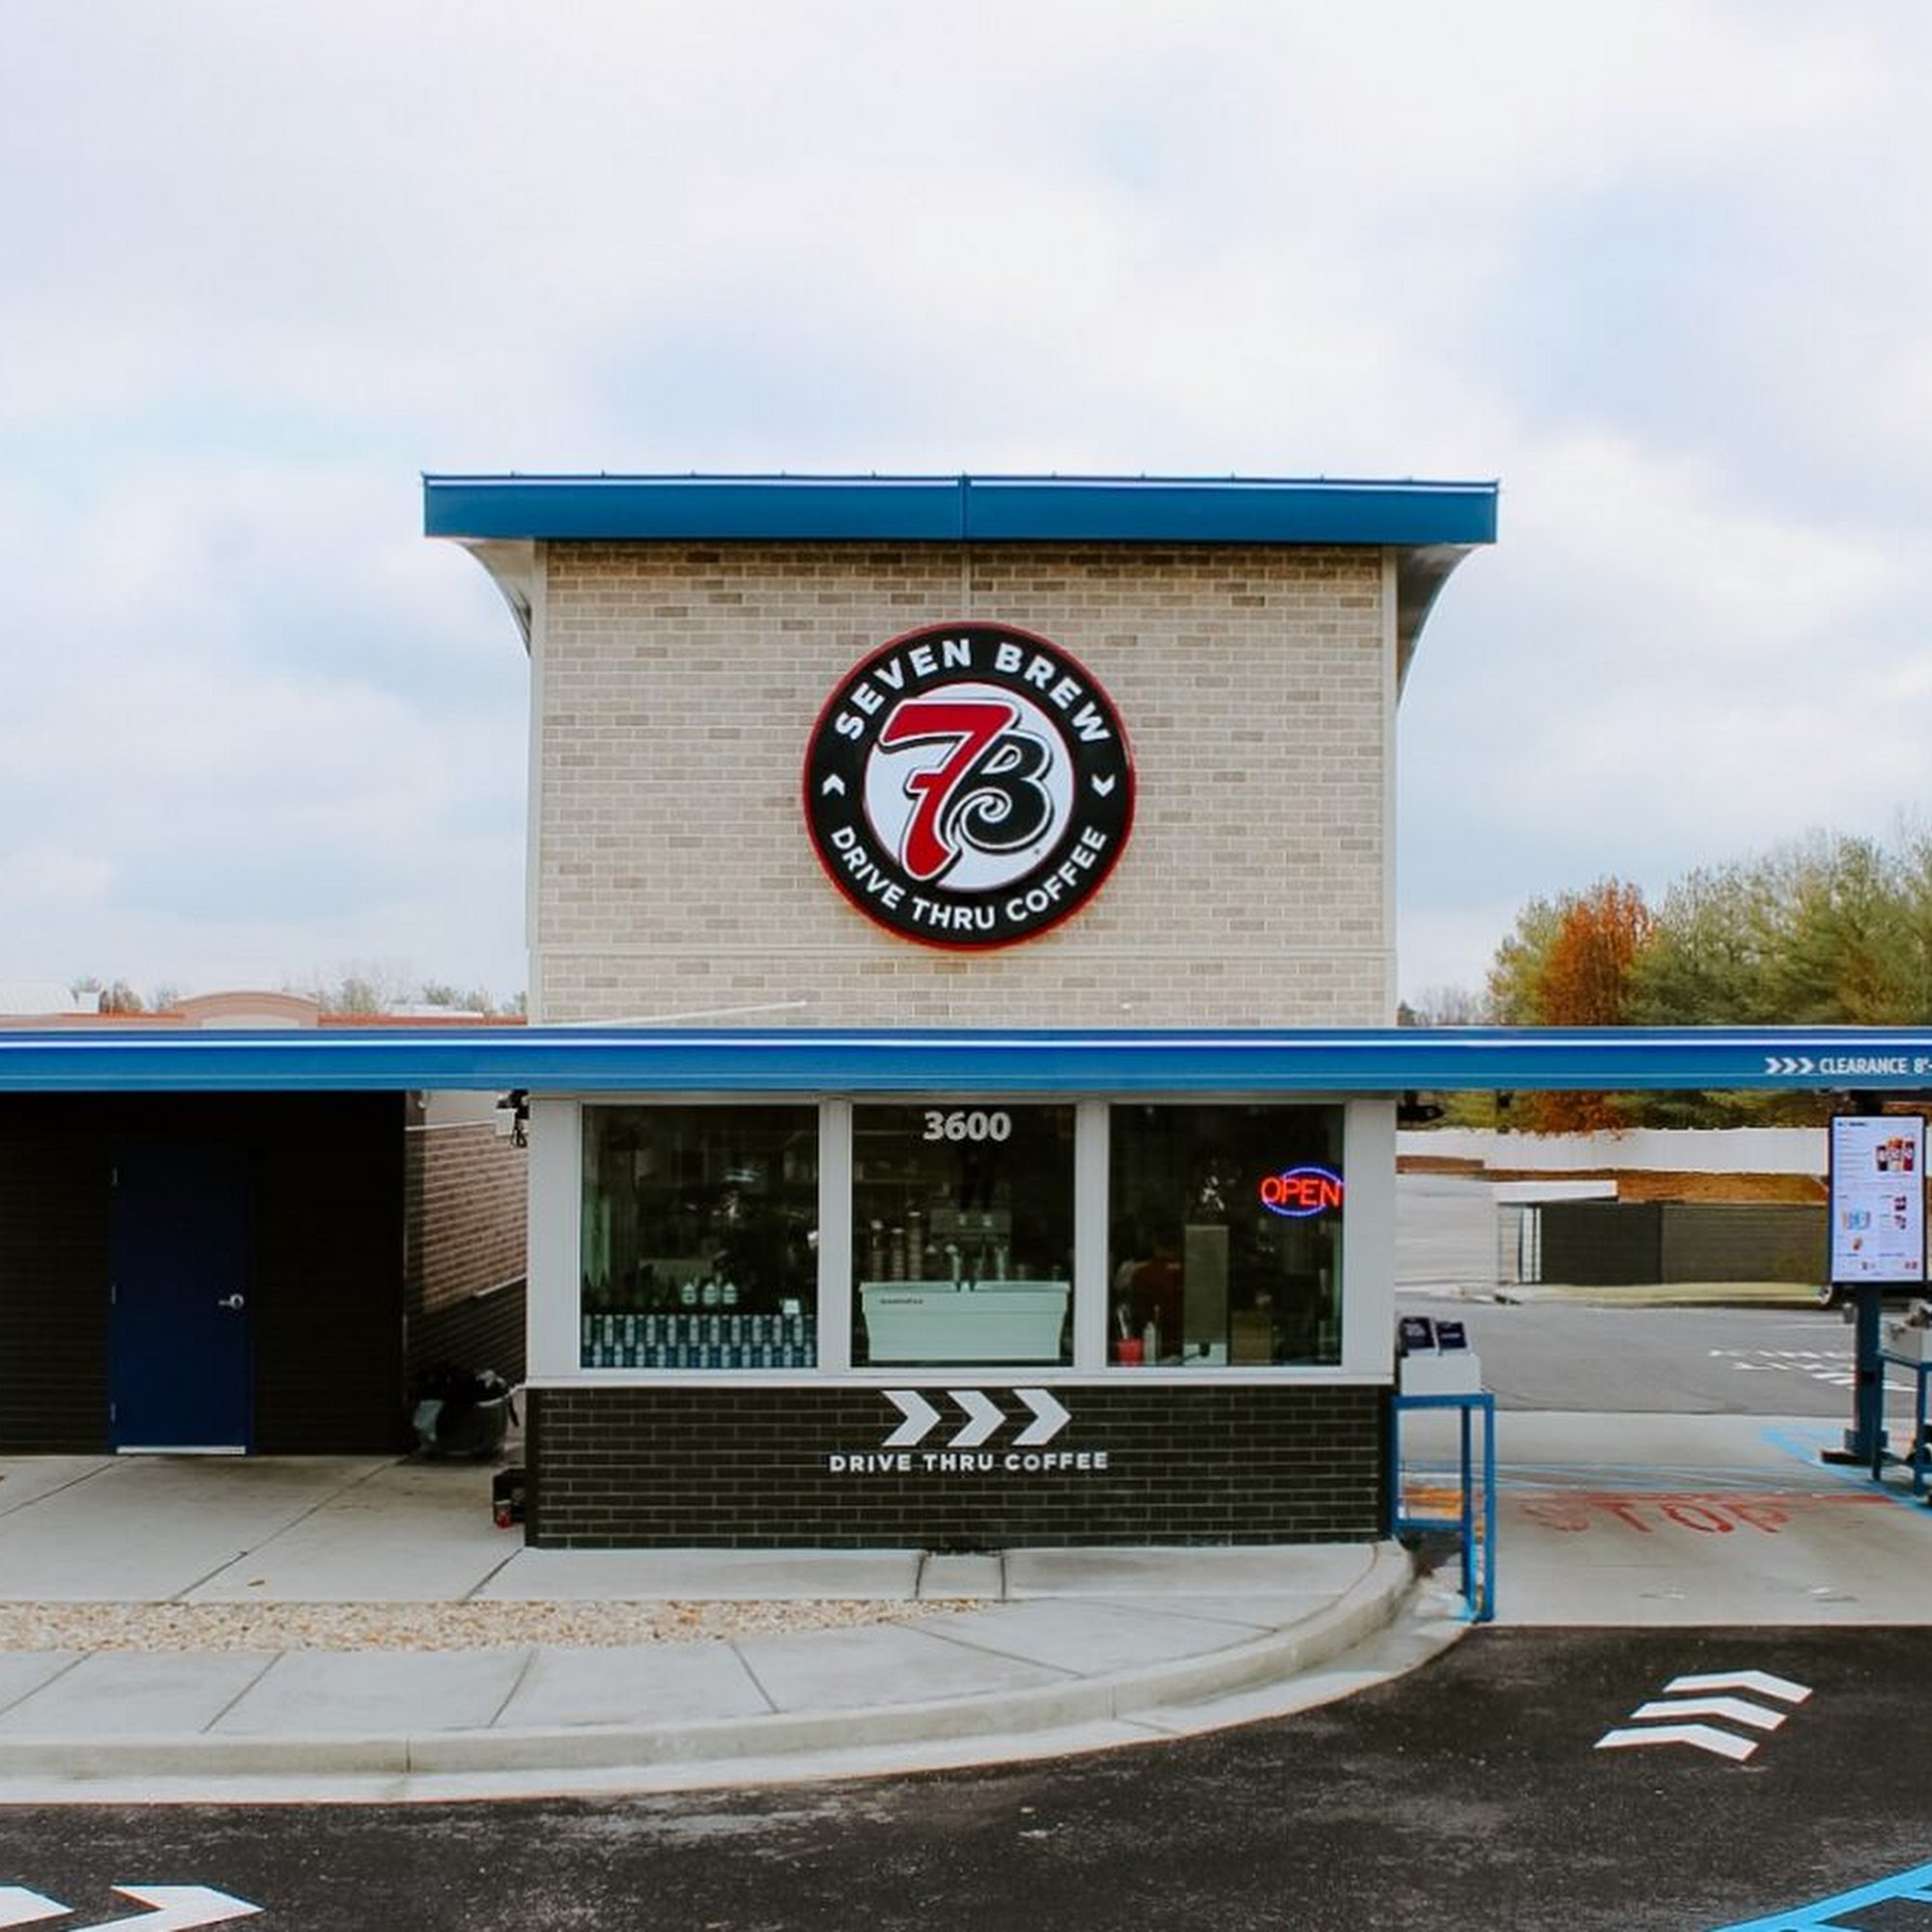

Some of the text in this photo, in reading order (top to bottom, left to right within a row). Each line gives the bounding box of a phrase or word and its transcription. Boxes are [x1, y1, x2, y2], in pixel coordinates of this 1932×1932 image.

[836, 639, 1111, 744] SEVEN BREW
[831, 826, 1107, 930] DRIVE THRU COFFEE
[1819, 1057, 1908, 1074] CLEARANCE
[923, 1111, 1011, 1141] 3600
[1261, 1177, 1340, 1207] OPEN
[830, 1452, 1108, 1472] DRIVE THRU COFFEE
[1520, 1495, 1790, 1533] STOP
